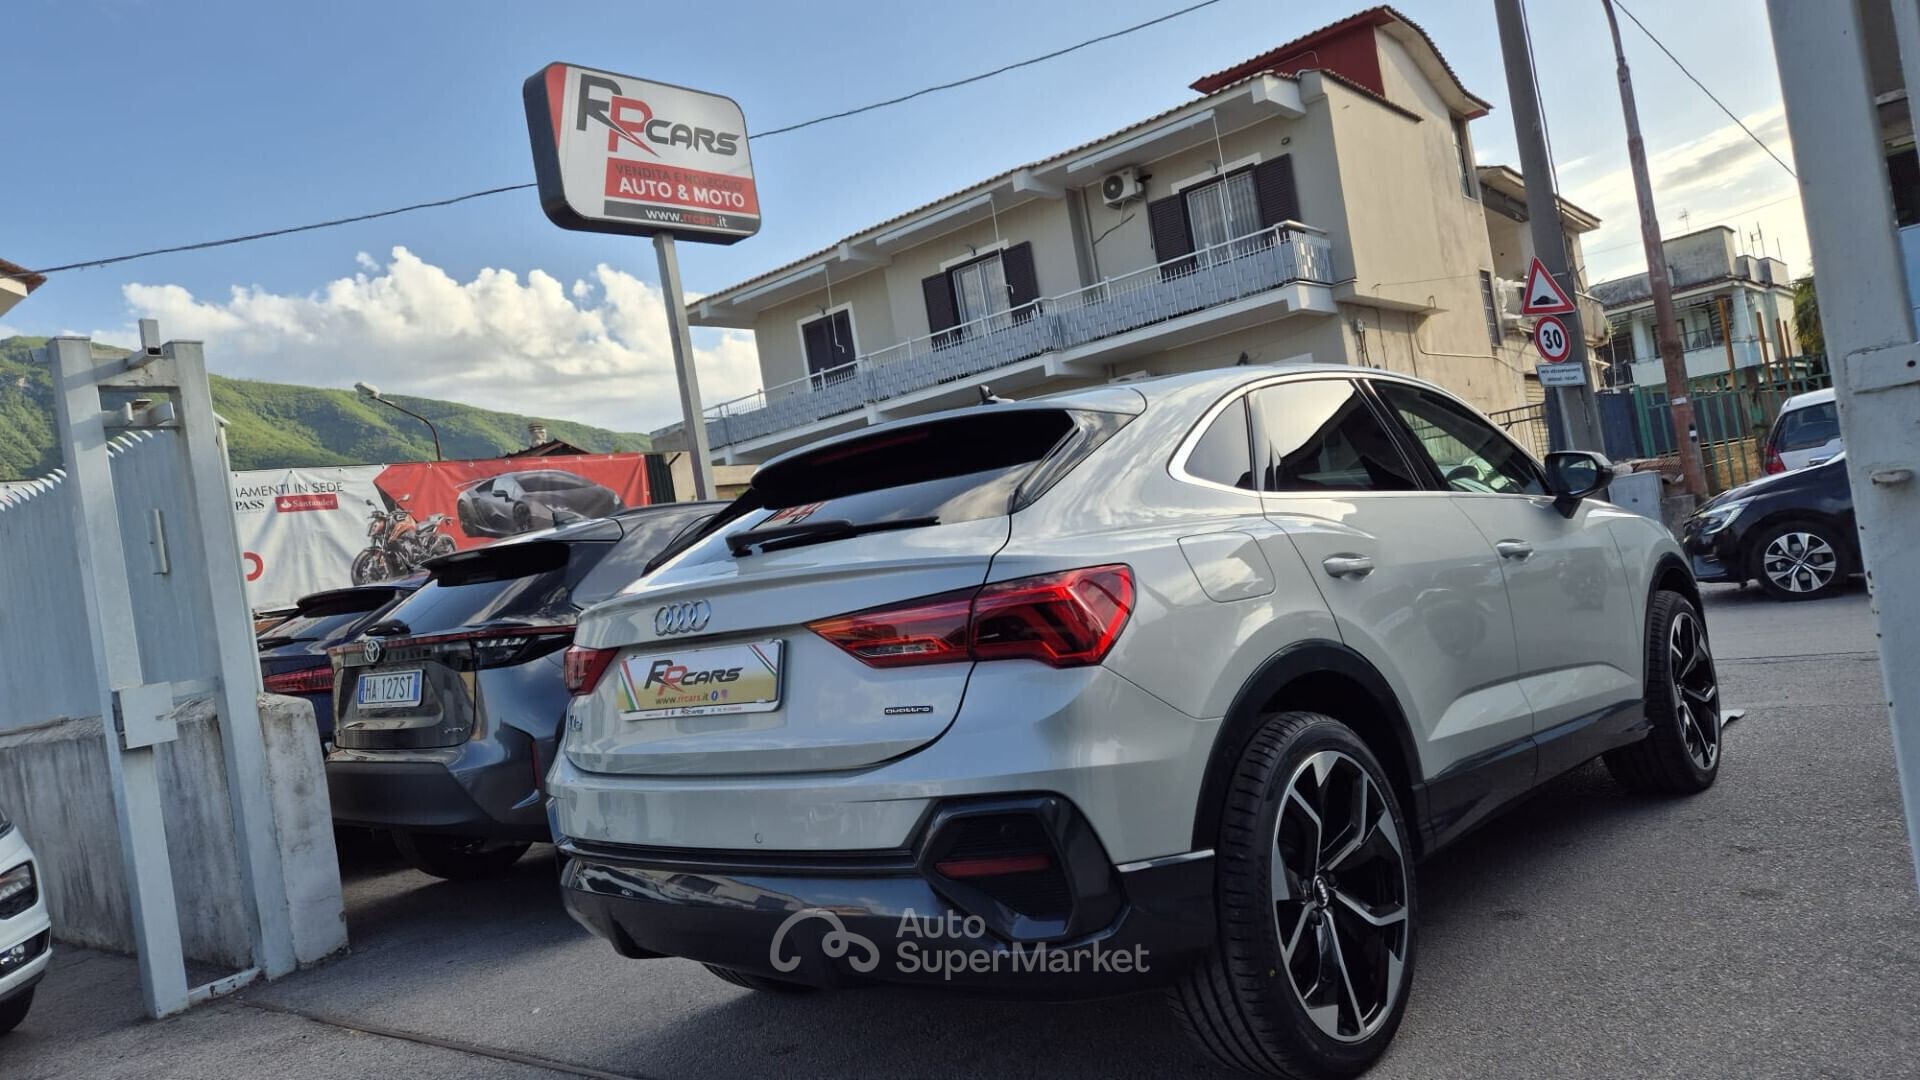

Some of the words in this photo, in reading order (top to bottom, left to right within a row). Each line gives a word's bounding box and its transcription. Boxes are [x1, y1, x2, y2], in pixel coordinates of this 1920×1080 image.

[615, 163, 670, 181] VENDITA
[673, 173, 682, 182] E
[684, 174, 743, 190] NOLEGGIO
[619, 177, 672, 198] AUTO
[678, 184, 689, 201] &
[693, 187, 745, 208] MOTO
[645, 209, 728, 228] www.rrcars.it
[1543, 329, 1563, 349] 30
[294, 483, 308, 493] IN
[312, 481, 344, 493] SEDE
[292, 498, 334, 507] Santander
[655, 693, 709, 705] www.rrcars.it
